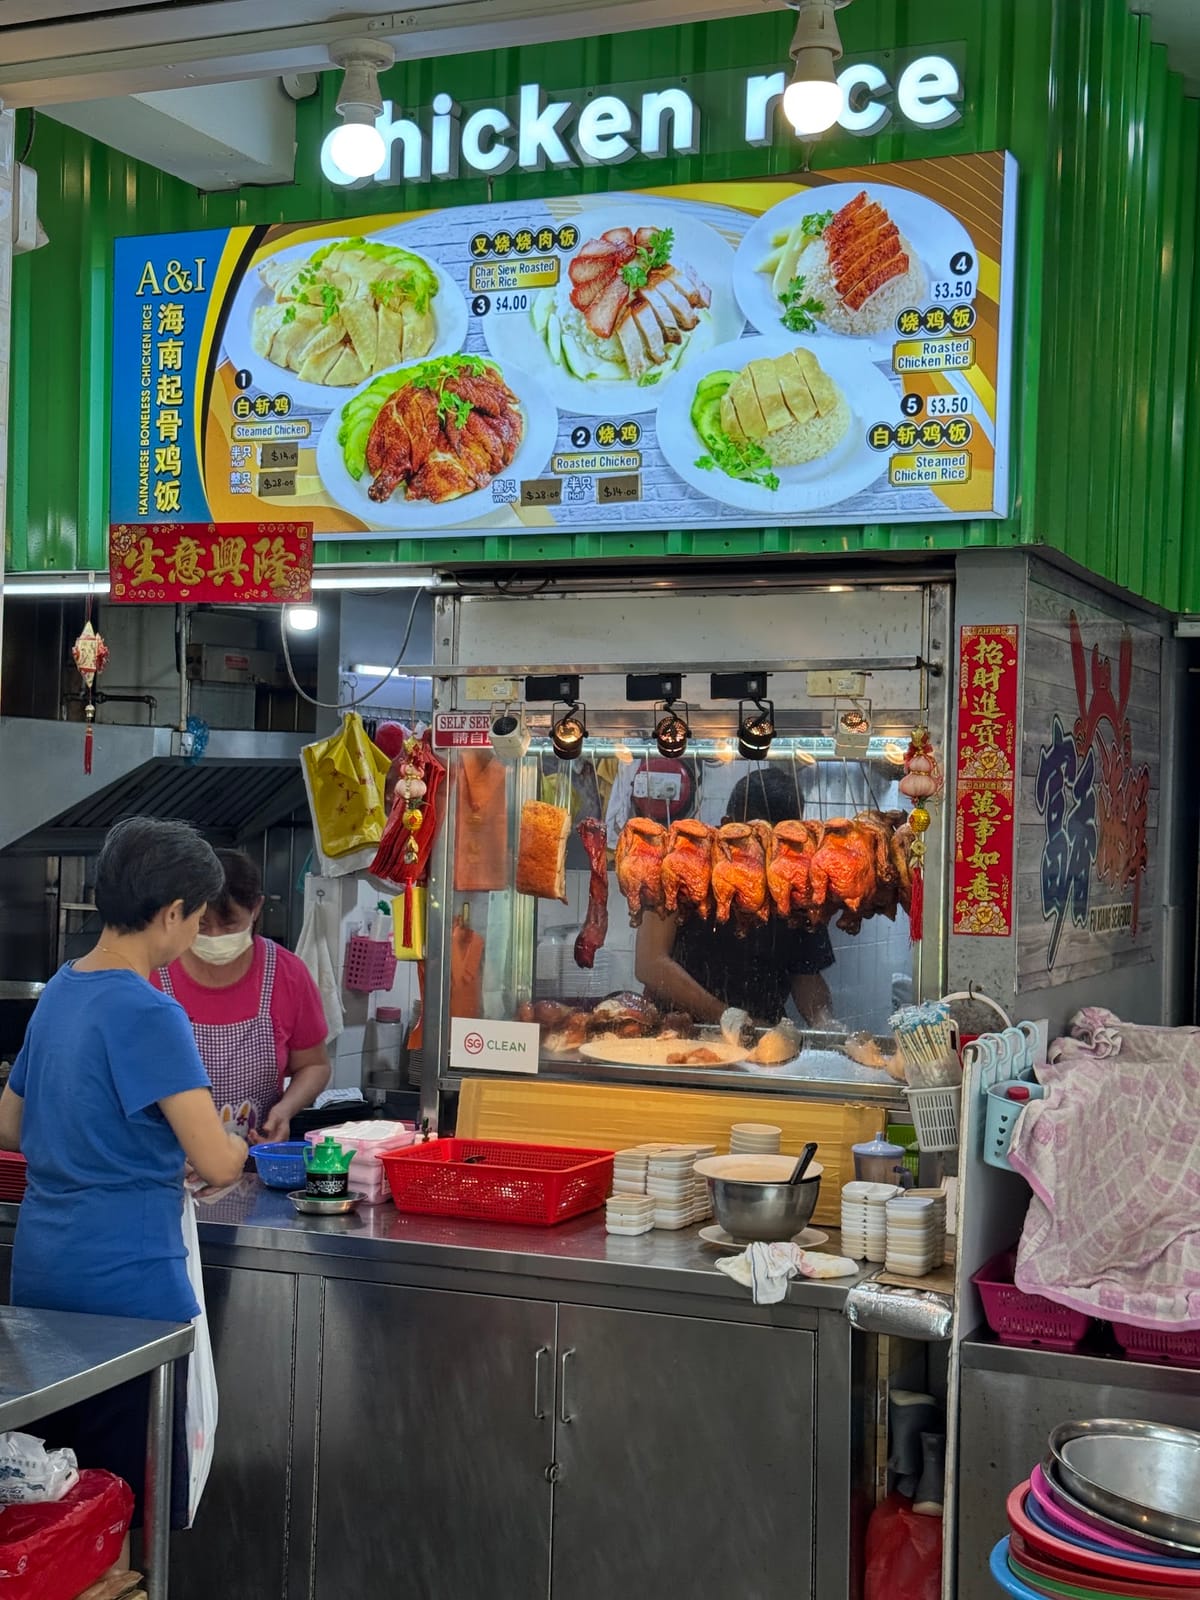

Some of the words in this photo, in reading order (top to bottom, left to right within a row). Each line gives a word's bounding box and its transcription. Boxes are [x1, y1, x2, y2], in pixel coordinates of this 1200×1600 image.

[745, 56, 961, 142] rce
[473, 228, 576, 255] 叉烧烧肉饭
[135, 257, 206, 297] A&I
[475, 265, 495, 278] Char
[497, 264, 517, 276] Siew
[519, 261, 555, 274] Roasted
[475, 278, 496, 289] Pork
[498, 276, 518, 288] Rice
[934, 280, 973, 300] $3.50
[495, 294, 528, 312] $4.00
[142, 304, 153, 330] RICE
[901, 308, 971, 332] 烧鸡饭
[923, 340, 970, 354] Roasted
[141, 333, 153, 387] CHICKEN
[897, 356, 941, 369] Chicken
[944, 354, 969, 366] Rice
[154, 302, 185, 512] 海南起骨鸡饭
[237, 396, 289, 416] 白斩鸡
[930, 396, 969, 415] $3.50
[140, 389, 151, 447] BONELESS
[236, 426, 273, 438] Steamed
[274, 424, 307, 436] Chicken
[598, 424, 638, 445] 烧鸡
[873, 422, 968, 446] 白斩鸡饭
[556, 456, 597, 470] Roasted
[599, 455, 638, 468] Chicken
[915, 454, 966, 468] Steamed
[138, 449, 151, 516] HAINANESE
[894, 469, 937, 482] Chicken
[941, 467, 965, 480] Rice
[230, 486, 253, 495] Whole
[492, 495, 518, 503] Whole
[603, 485, 638, 498] $14.00
[123, 535, 297, 589] 生意興隆
[969, 635, 1007, 750] 招財進寶
[440, 716, 467, 729] SELF
[469, 715, 491, 729] SER
[452, 731, 492, 745] 請自
[962, 790, 1002, 902] 萬事如意
[466, 1038, 482, 1049] SG
[486, 1039, 527, 1053] CLEAN
